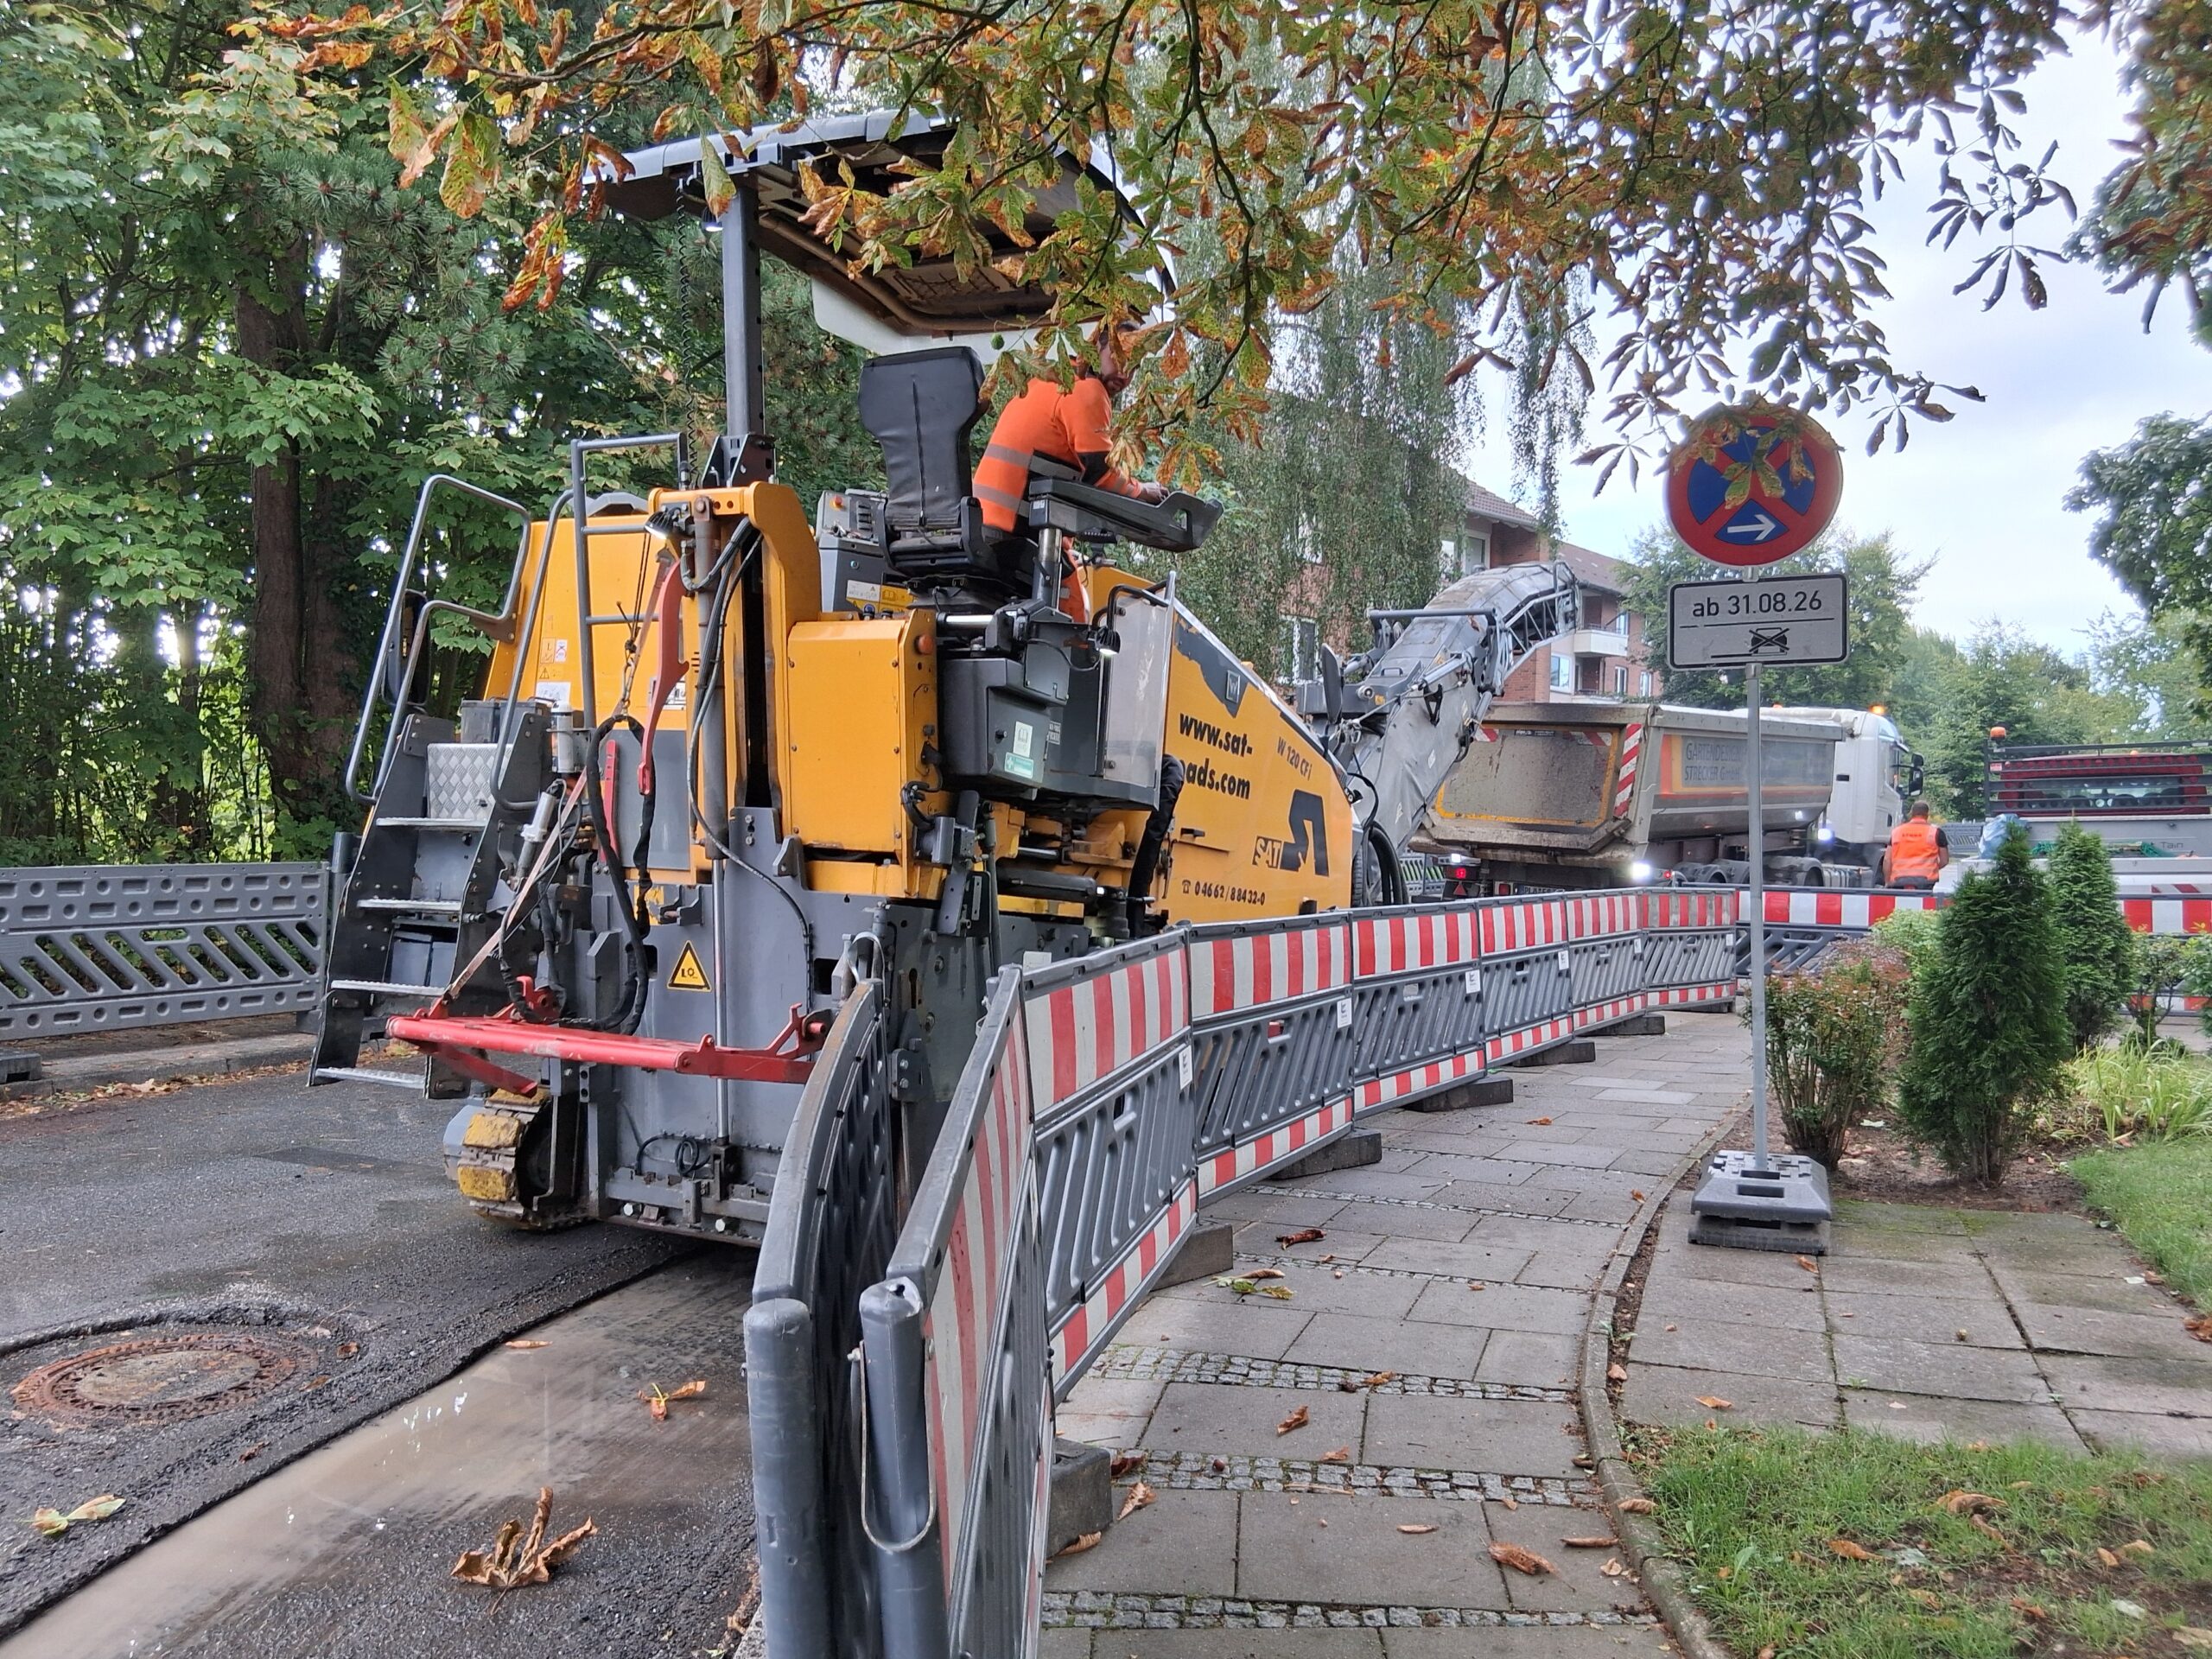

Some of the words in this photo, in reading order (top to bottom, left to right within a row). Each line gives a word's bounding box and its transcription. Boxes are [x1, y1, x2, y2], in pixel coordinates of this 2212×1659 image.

[1692, 597, 1719, 617] ab
[1727, 590, 1822, 615] 31.08.26
[1179, 712, 1253, 757] www.sat-
[1277, 736, 1287, 756] W
[1287, 746, 1300, 769] 120
[1685, 766, 1719, 781] STRECKER
[1255, 837, 1281, 868] SAT
[1194, 880, 1266, 906] 04662/88432-0
